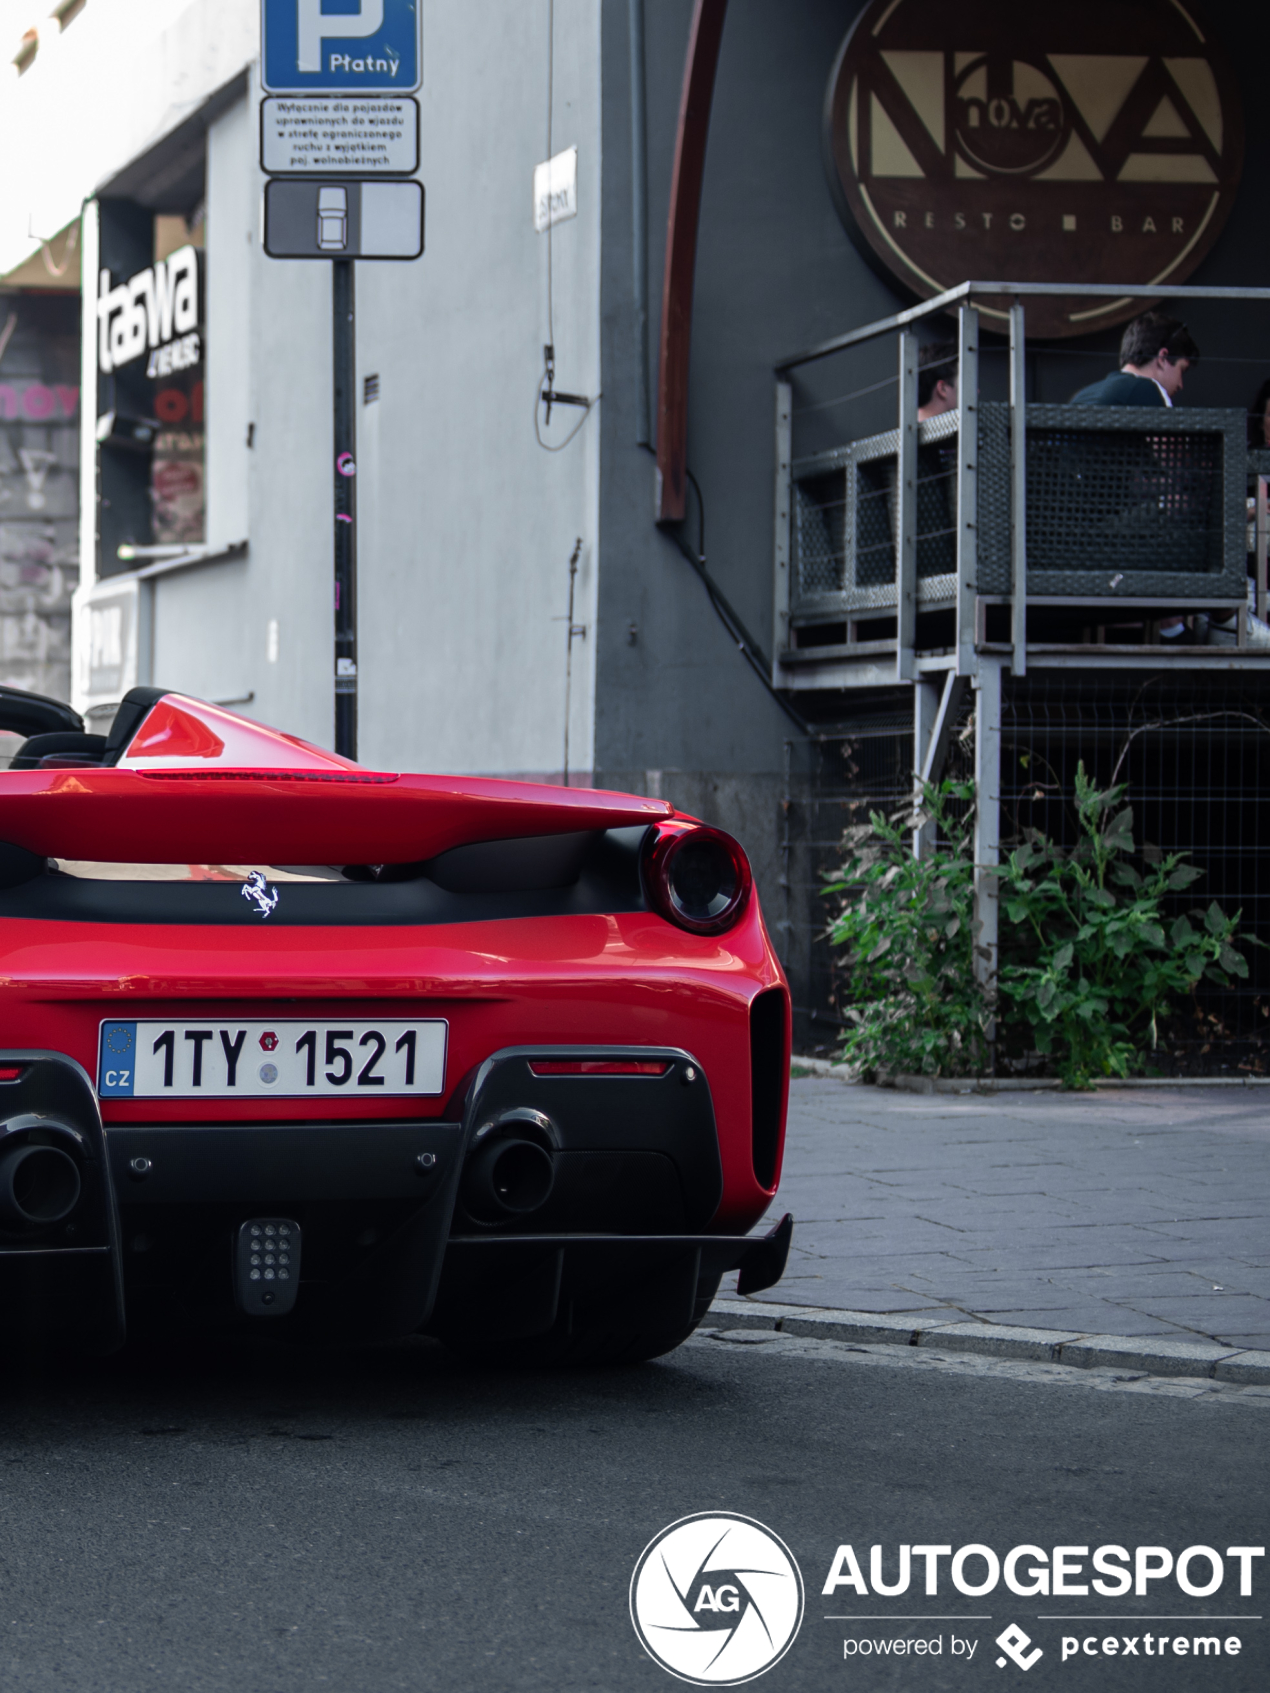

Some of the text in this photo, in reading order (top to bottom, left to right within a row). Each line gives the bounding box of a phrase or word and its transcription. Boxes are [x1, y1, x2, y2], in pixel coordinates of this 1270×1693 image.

[298, 0, 384, 72] P
[330, 54, 400, 77] Płatny
[277, 103, 402, 114] Wyłącznie dla pojazdów
[276, 116, 404, 127] uprawnionych do wjazdu
[278, 129, 402, 140] w strefę ograniczonego
[293, 142, 323, 151] ruchu
[334, 142, 387, 153] wyjątkiem
[313, 155, 390, 167] wolnobieżnych
[894, 211, 1185, 233] RESTO BAR
[152, 1029, 418, 1087] 1TY 1521
[105, 1070, 130, 1087] CZ
